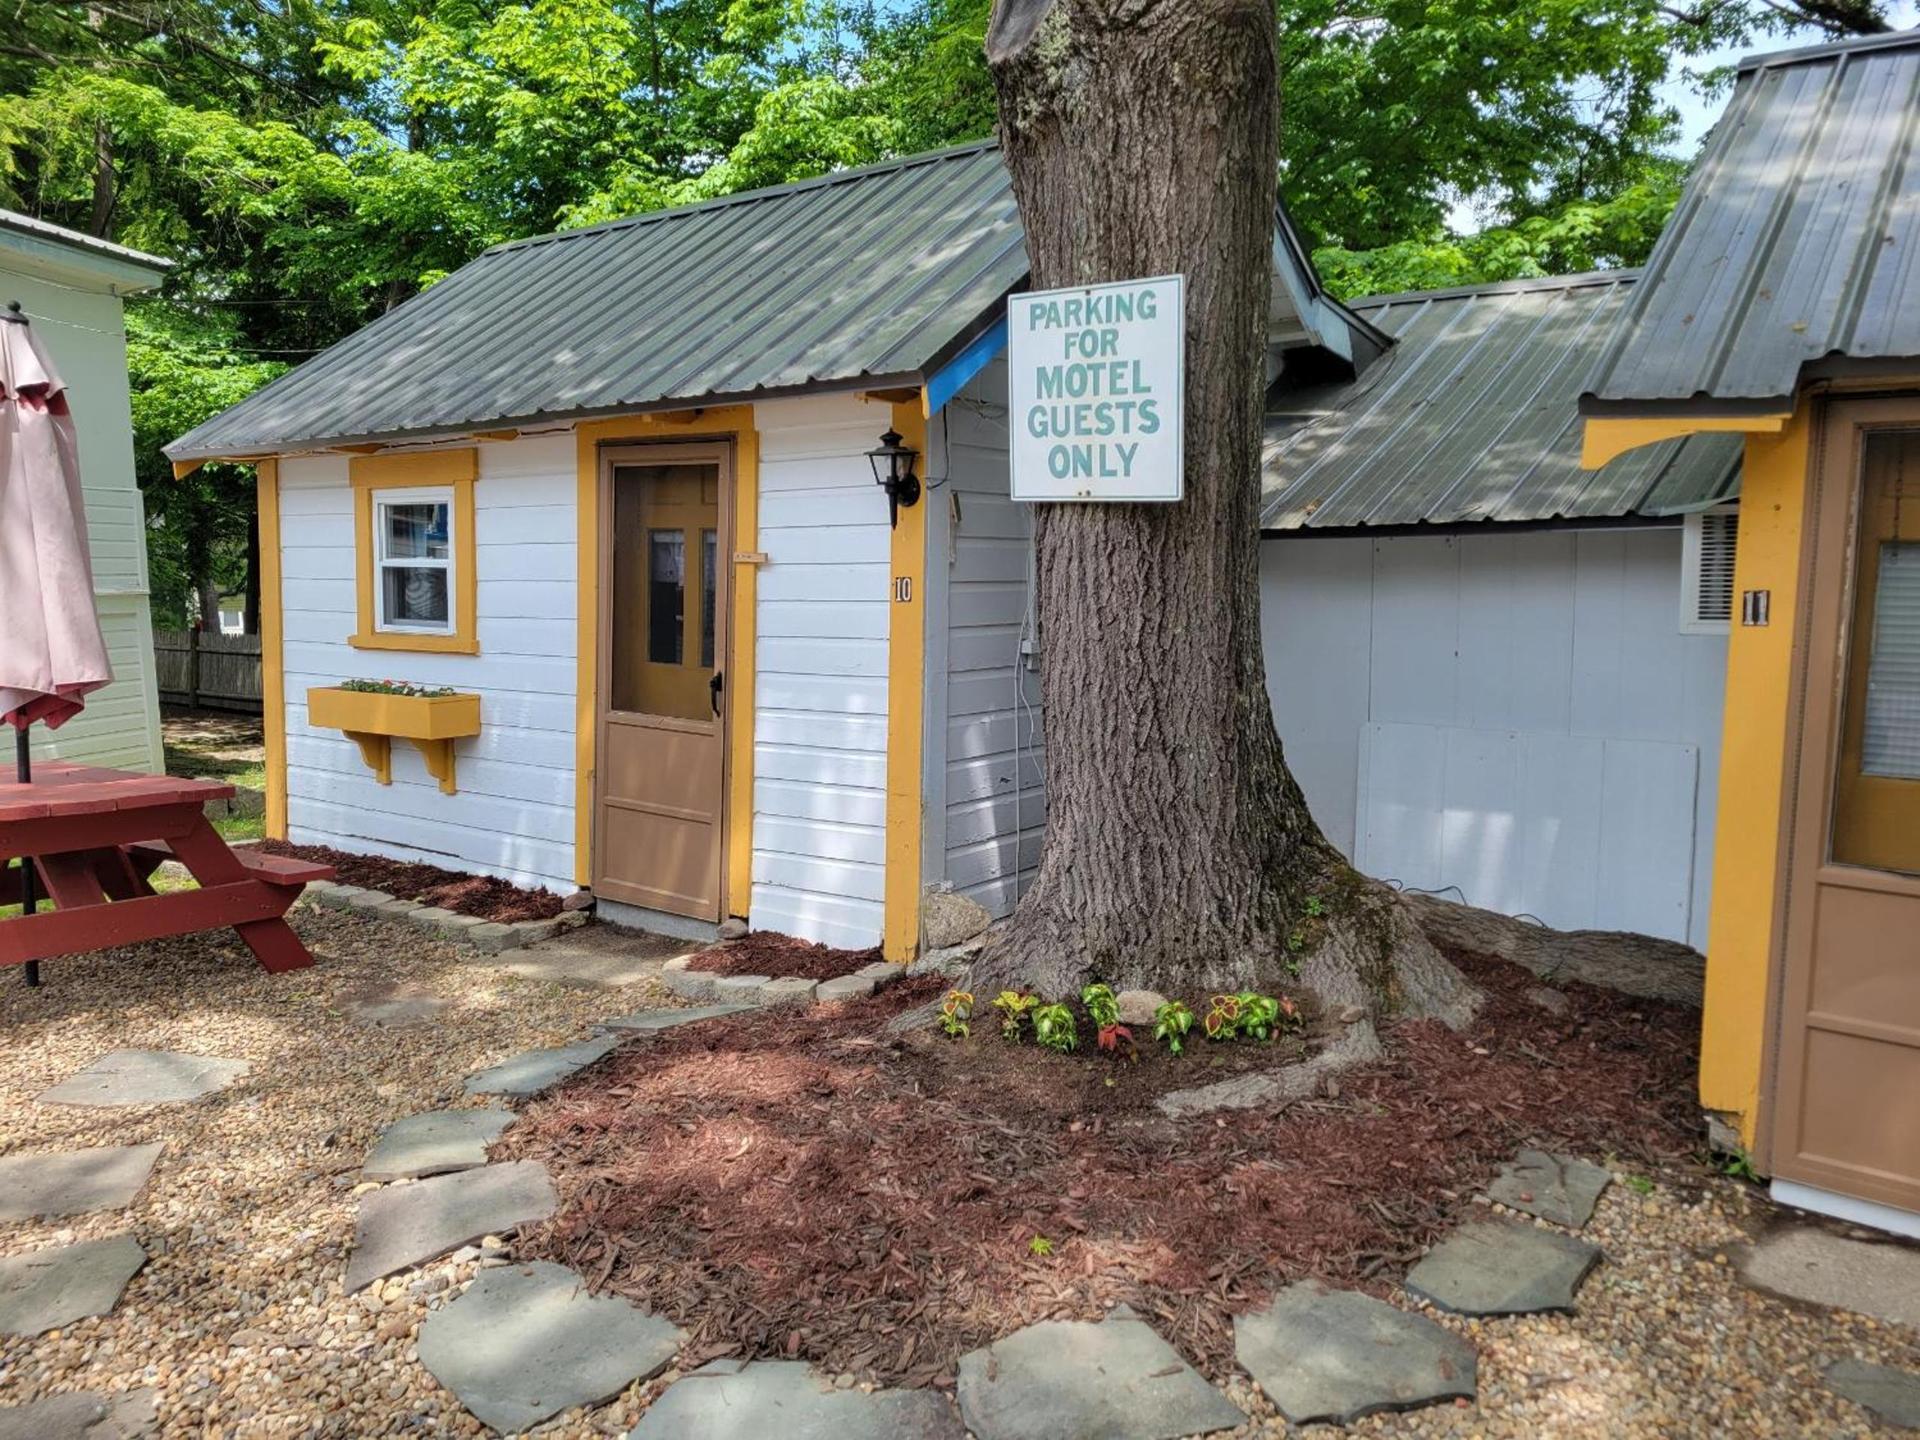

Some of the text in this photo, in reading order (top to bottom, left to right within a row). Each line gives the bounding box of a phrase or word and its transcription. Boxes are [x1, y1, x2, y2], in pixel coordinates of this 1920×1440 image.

[1029, 289, 1157, 331] PARKING
[1064, 328, 1119, 360] FOR
[1036, 360, 1152, 400] MOTEL
[1027, 399, 1161, 439] GUESTS
[1047, 442, 1139, 480] ONLY
[896, 577, 911, 602] 10
[1743, 591, 1769, 626] 11
